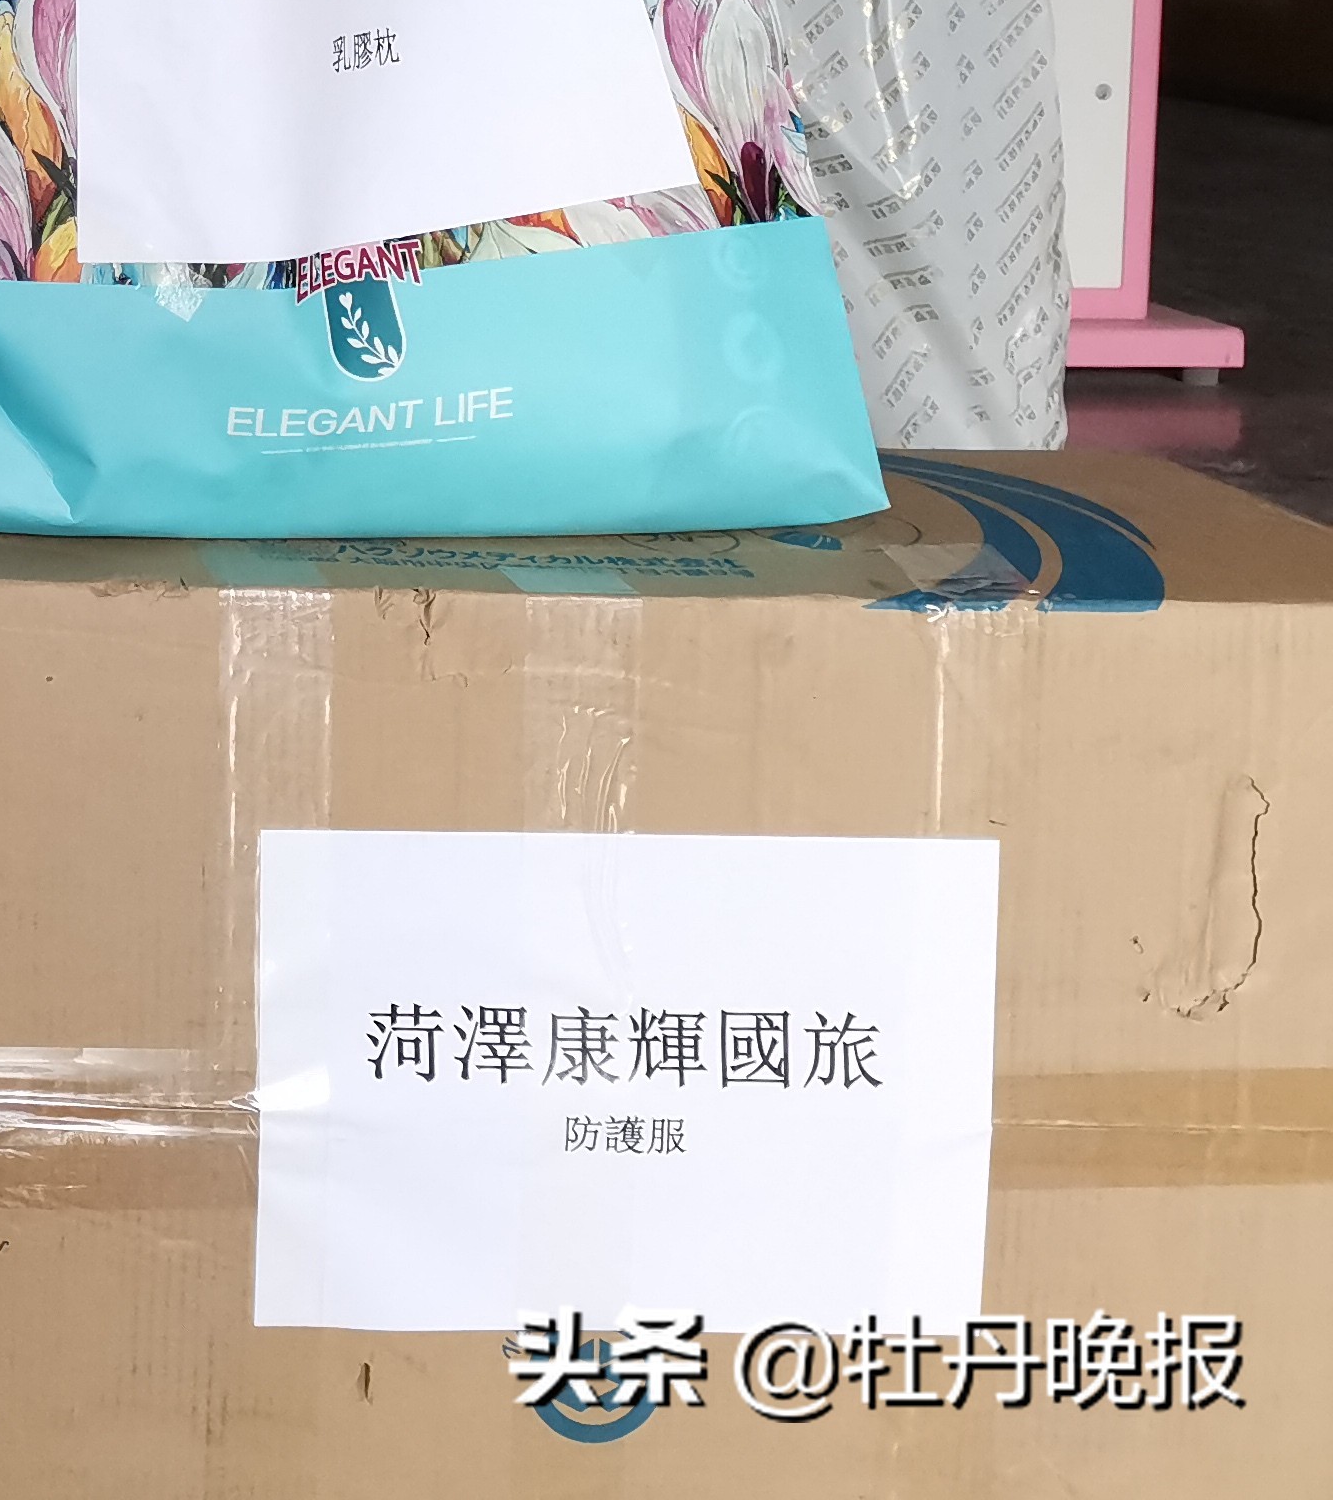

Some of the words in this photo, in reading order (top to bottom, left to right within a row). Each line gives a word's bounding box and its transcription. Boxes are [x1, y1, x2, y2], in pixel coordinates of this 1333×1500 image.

[332, 27, 401, 73] 乳膠枕
[296, 240, 421, 303] ELEGANT
[228, 399, 422, 438] ELEGANT
[434, 386, 514, 427] LIFE
[366, 1003, 883, 1091] 菏澤康輝國旅
[564, 1115, 687, 1157] 防護服
